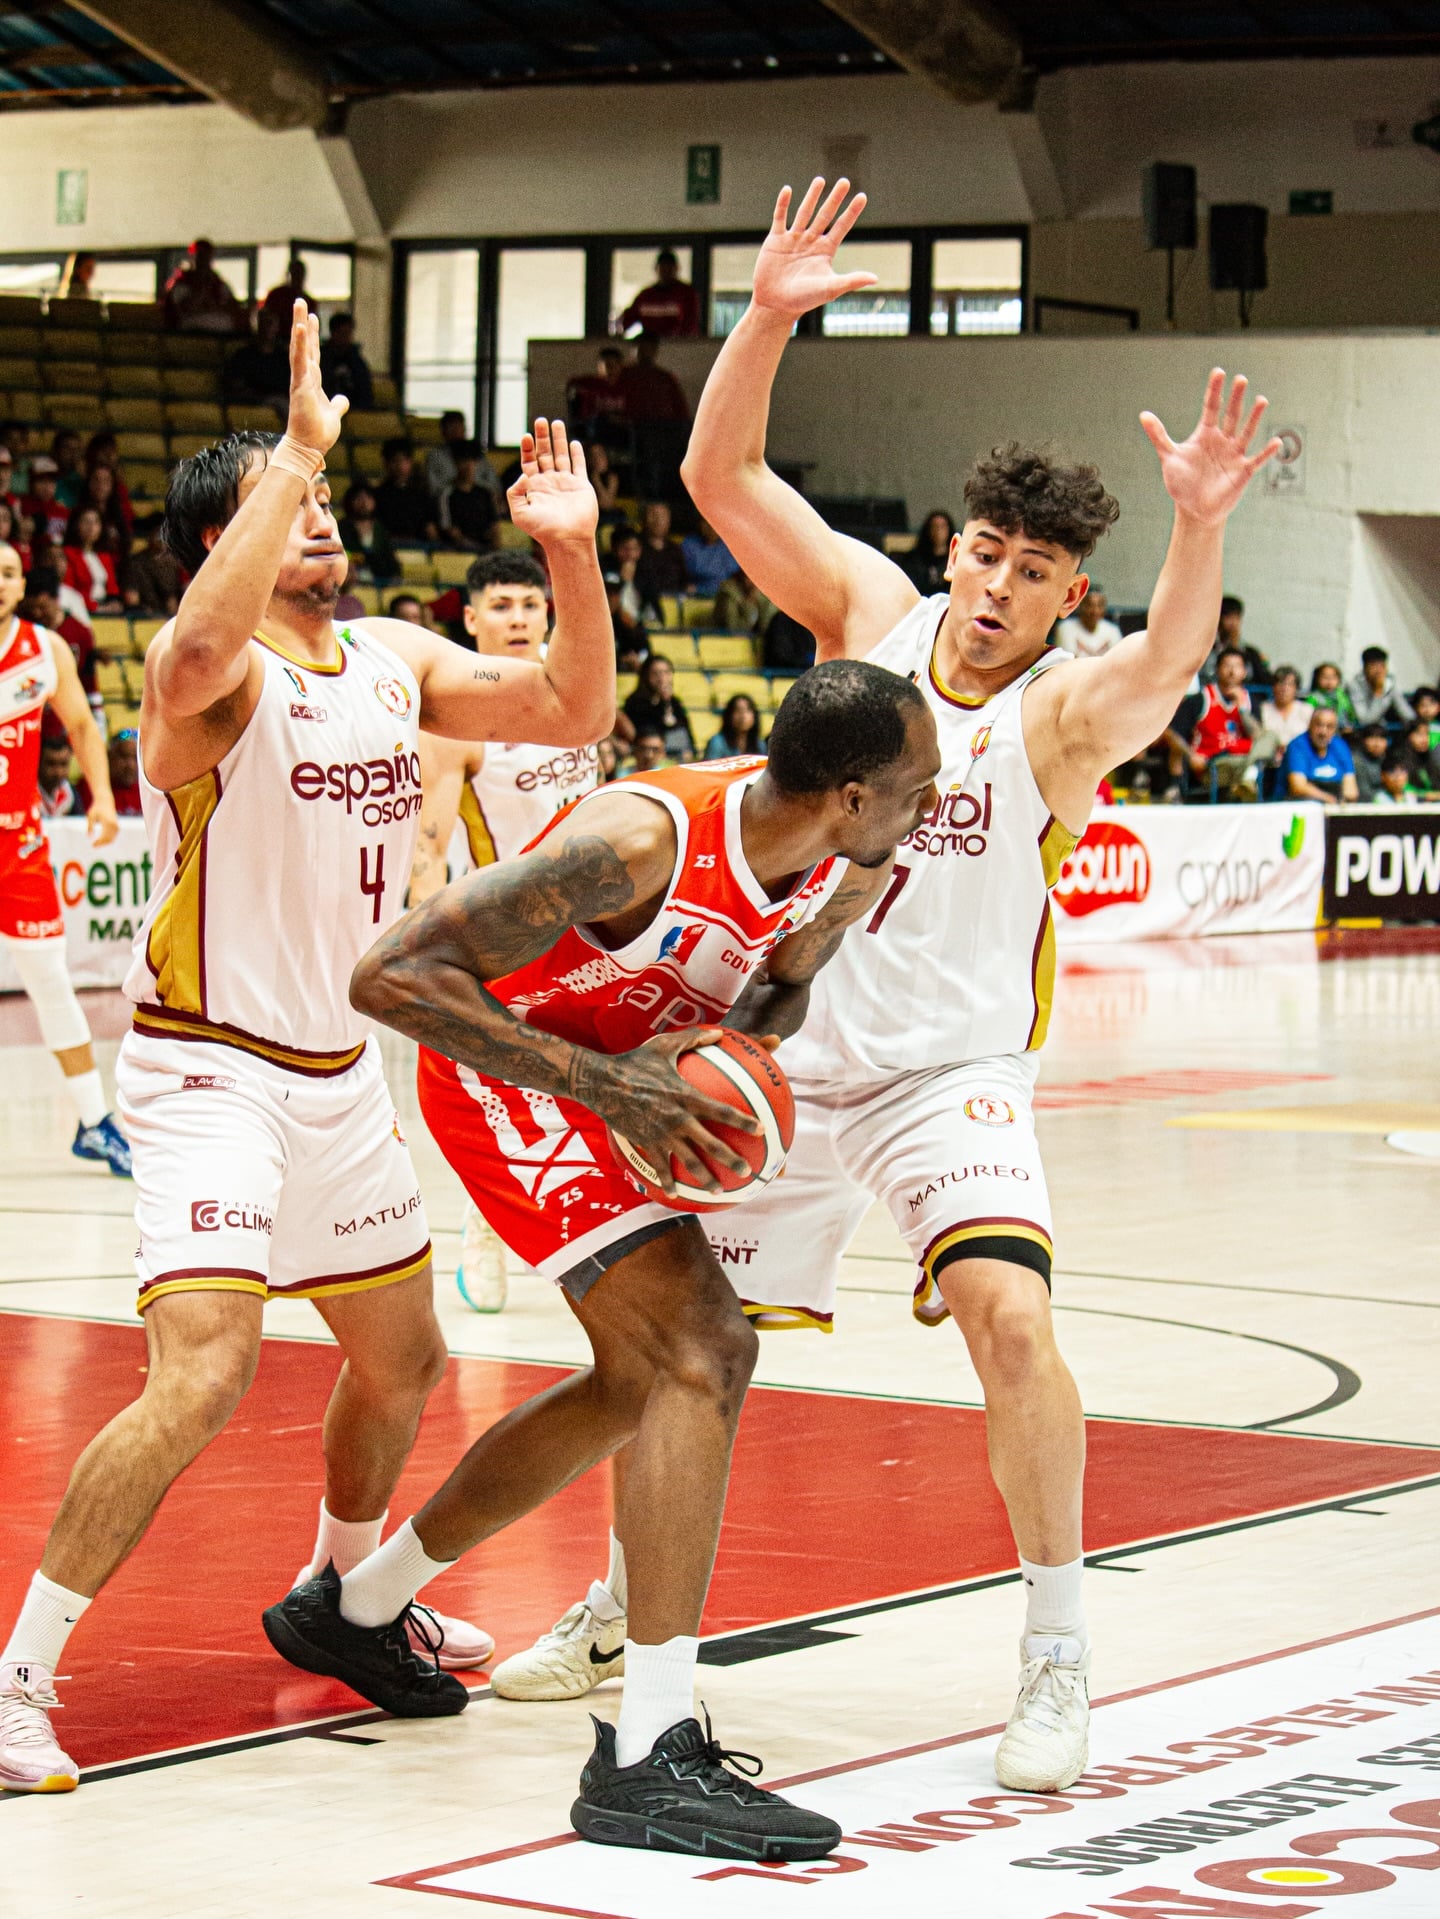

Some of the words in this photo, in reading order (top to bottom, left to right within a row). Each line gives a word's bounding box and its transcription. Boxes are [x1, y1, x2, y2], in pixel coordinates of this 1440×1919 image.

[360, 844, 385, 923] 4
[16, 918, 63, 939] tape
[89, 918, 144, 942] MA
[909, 1164, 1030, 1213] MATUREO
